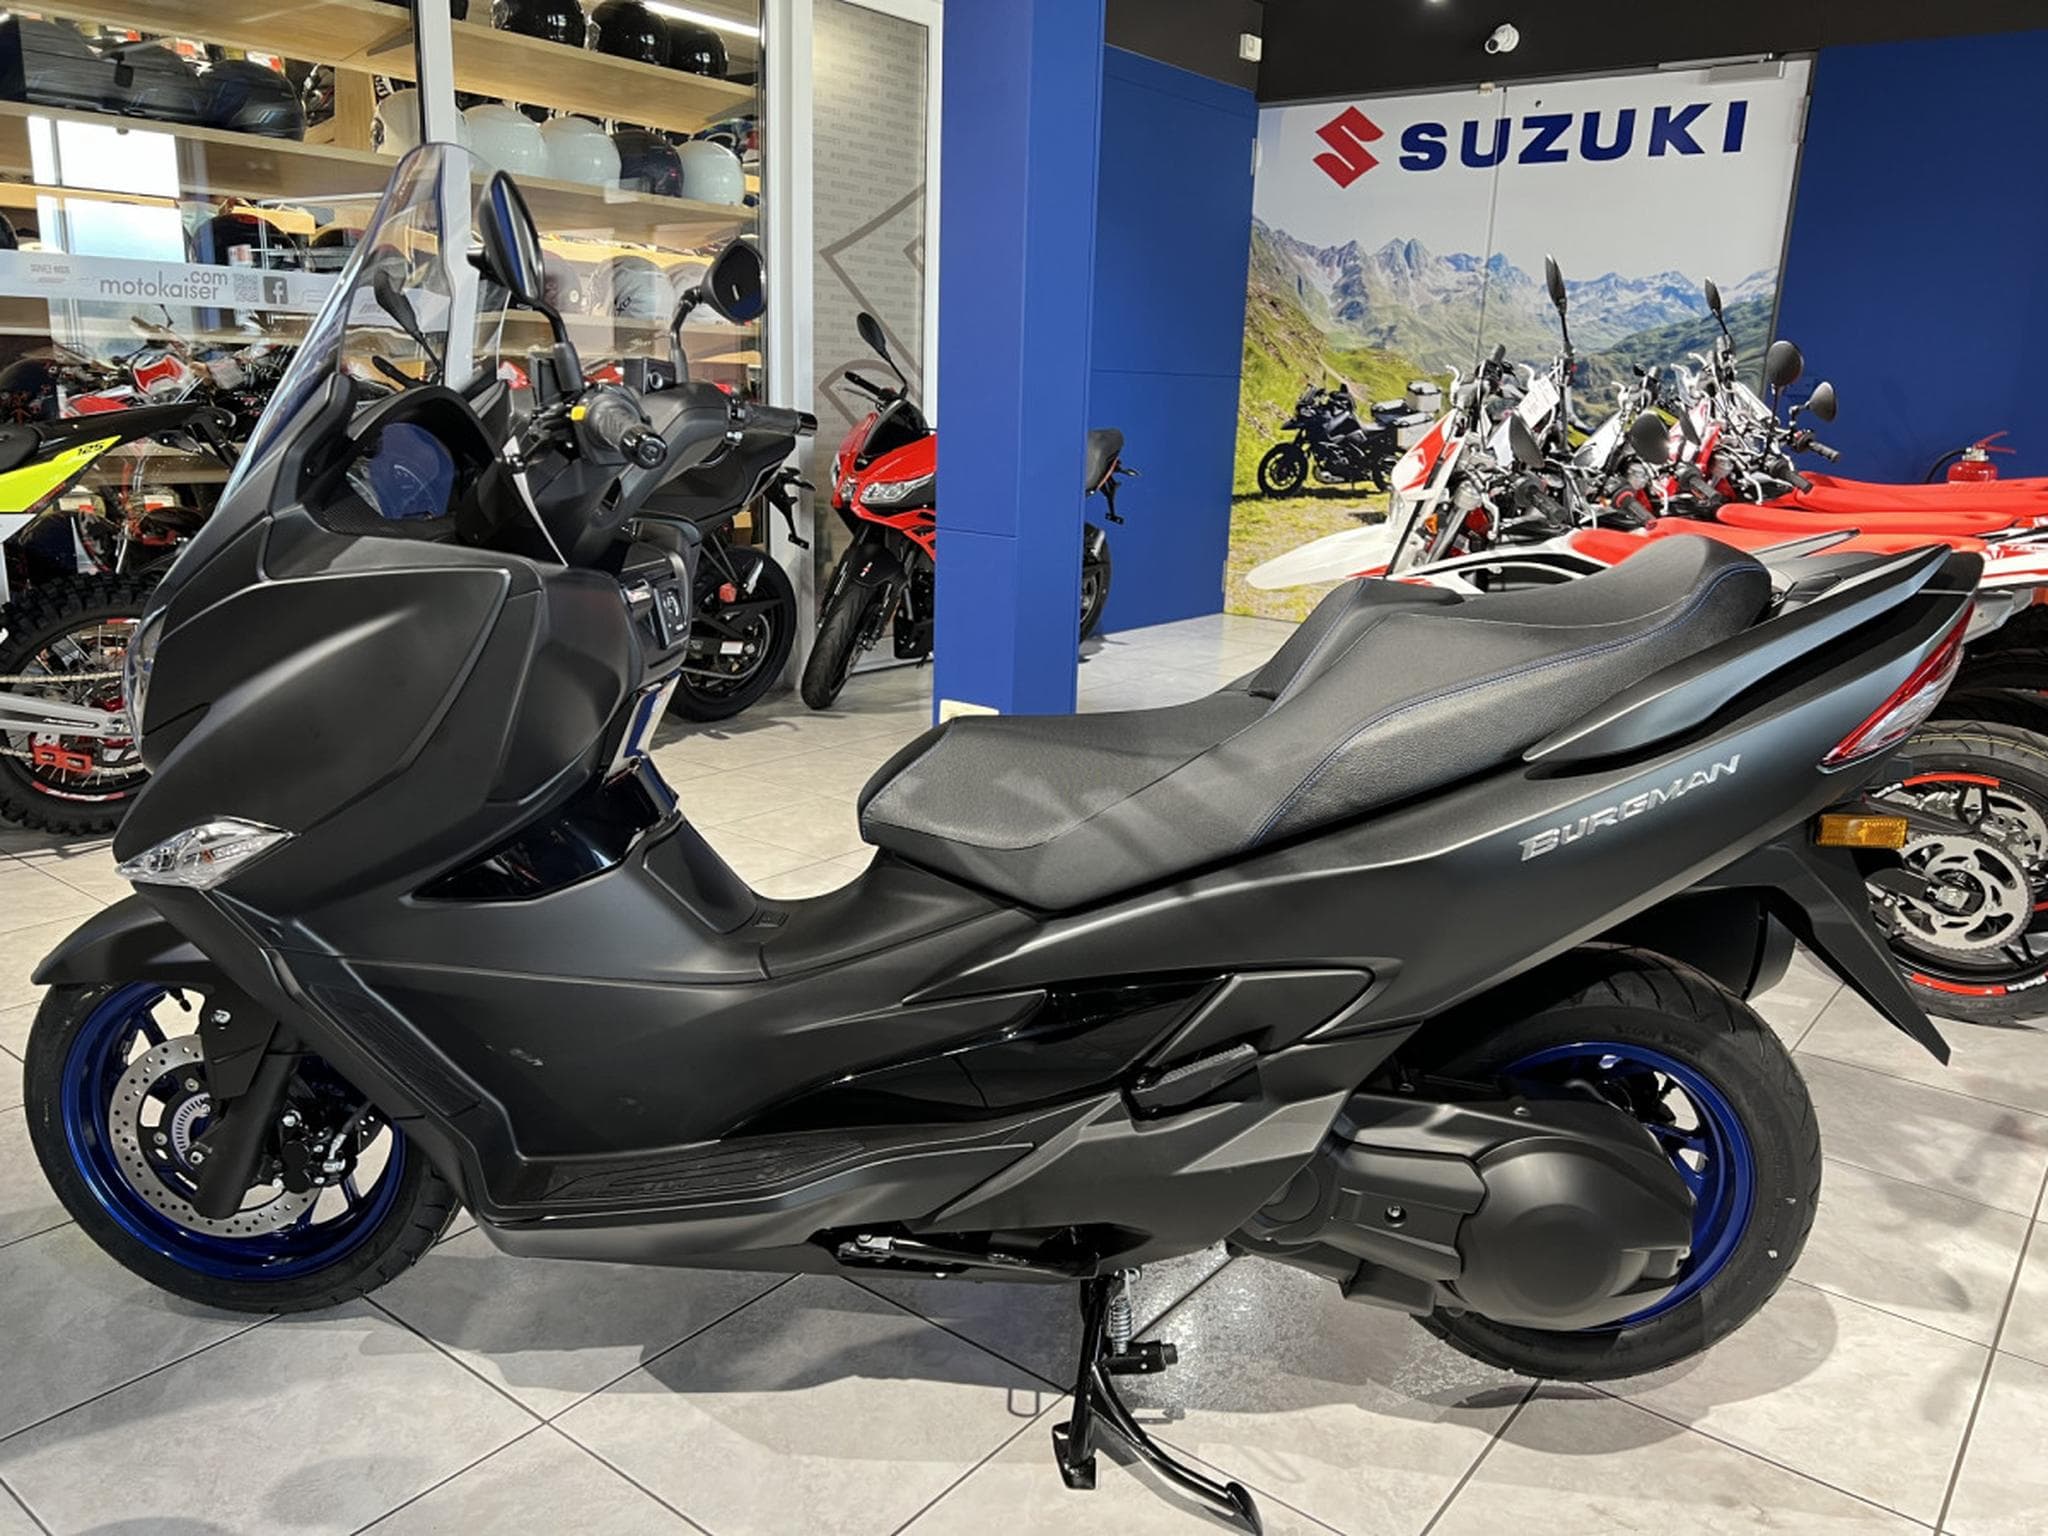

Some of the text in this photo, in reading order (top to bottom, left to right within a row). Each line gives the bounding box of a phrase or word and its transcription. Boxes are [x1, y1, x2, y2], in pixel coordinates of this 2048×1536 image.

[1399, 100, 1748, 171] SUZUKI
[100, 271, 219, 300] motokaiser
[1518, 754, 1741, 862] BURGMAN
